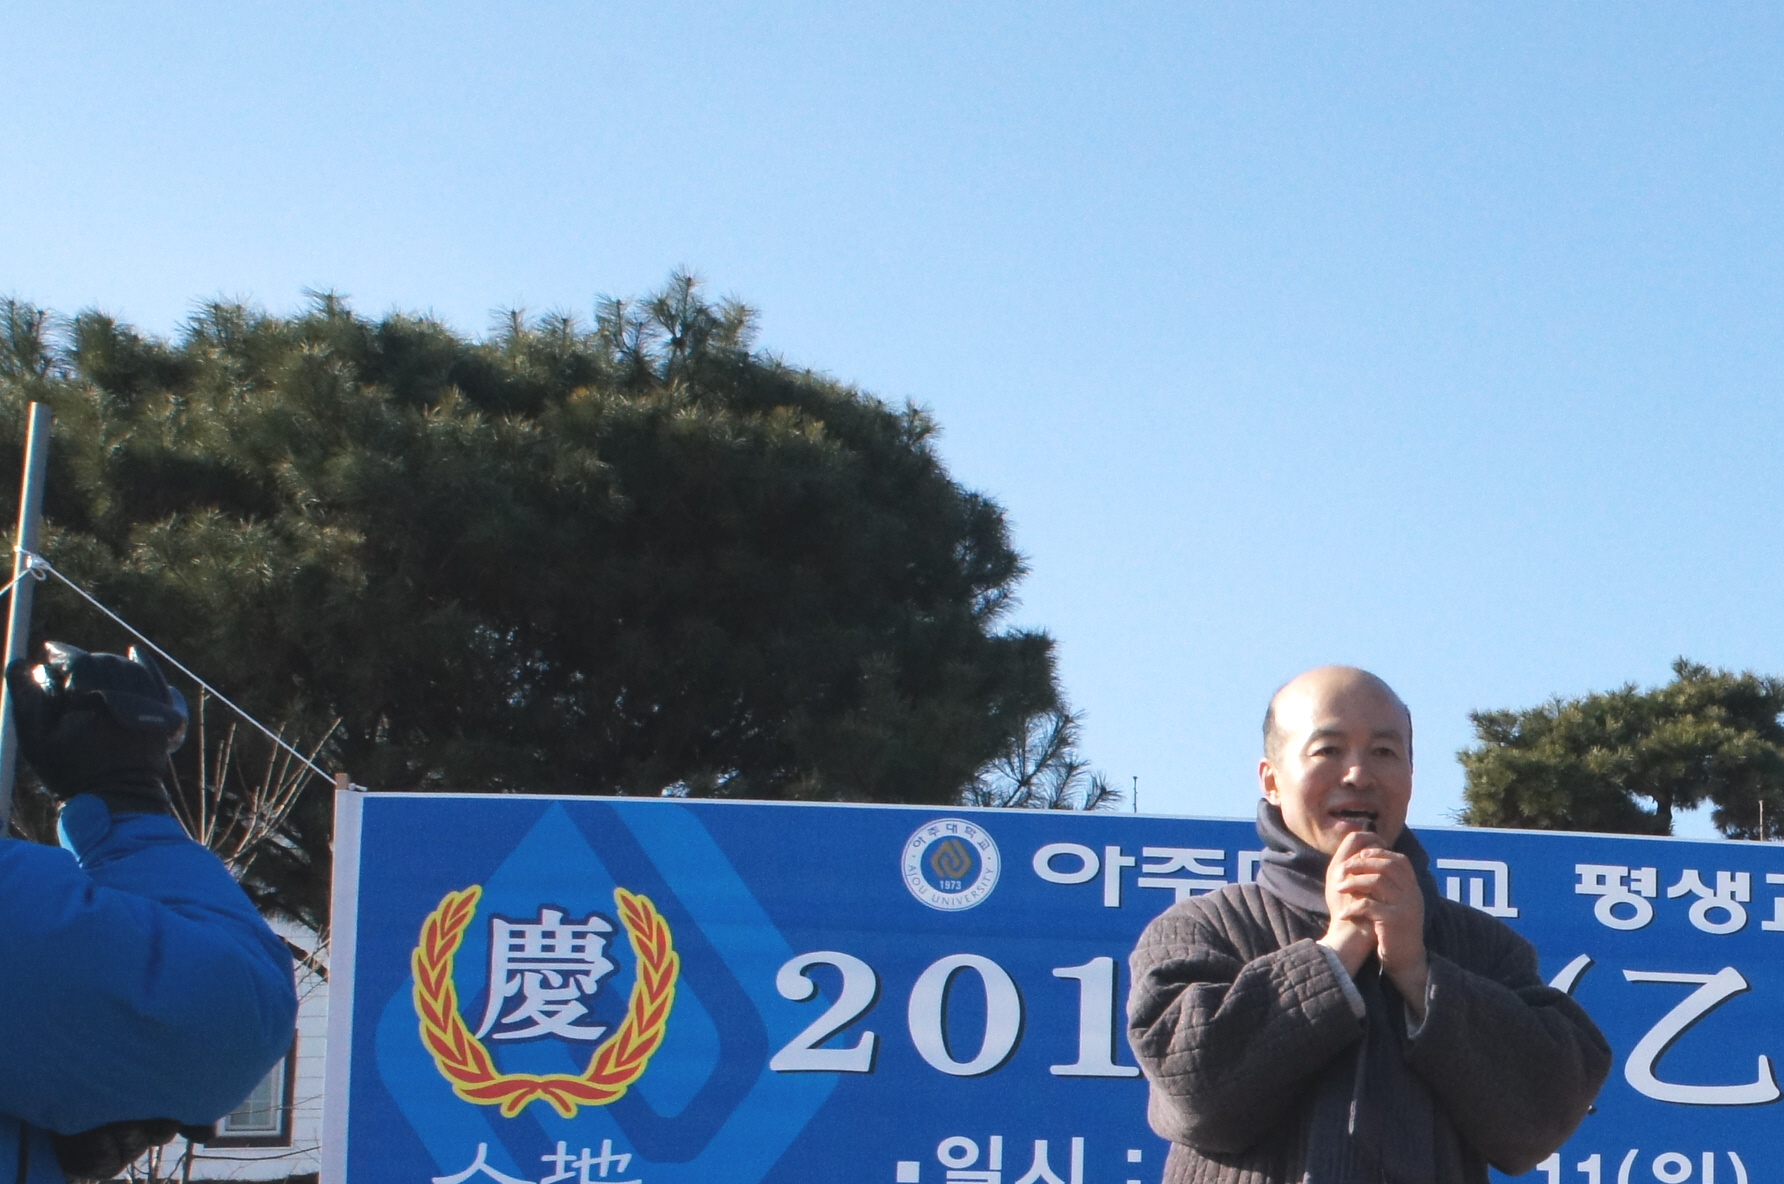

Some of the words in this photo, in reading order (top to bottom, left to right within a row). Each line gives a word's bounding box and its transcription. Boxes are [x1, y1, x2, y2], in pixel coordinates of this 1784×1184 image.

[912, 822, 991, 852] 아주대학교
[907, 864, 928, 895] AJOU
[931, 867, 995, 906] UNIVERSITY
[939, 879, 962, 890] 1973
[1033, 843, 1517, 917] 아주교
[481, 910, 613, 1041] 慶
[769, 951, 1139, 1077] 201
